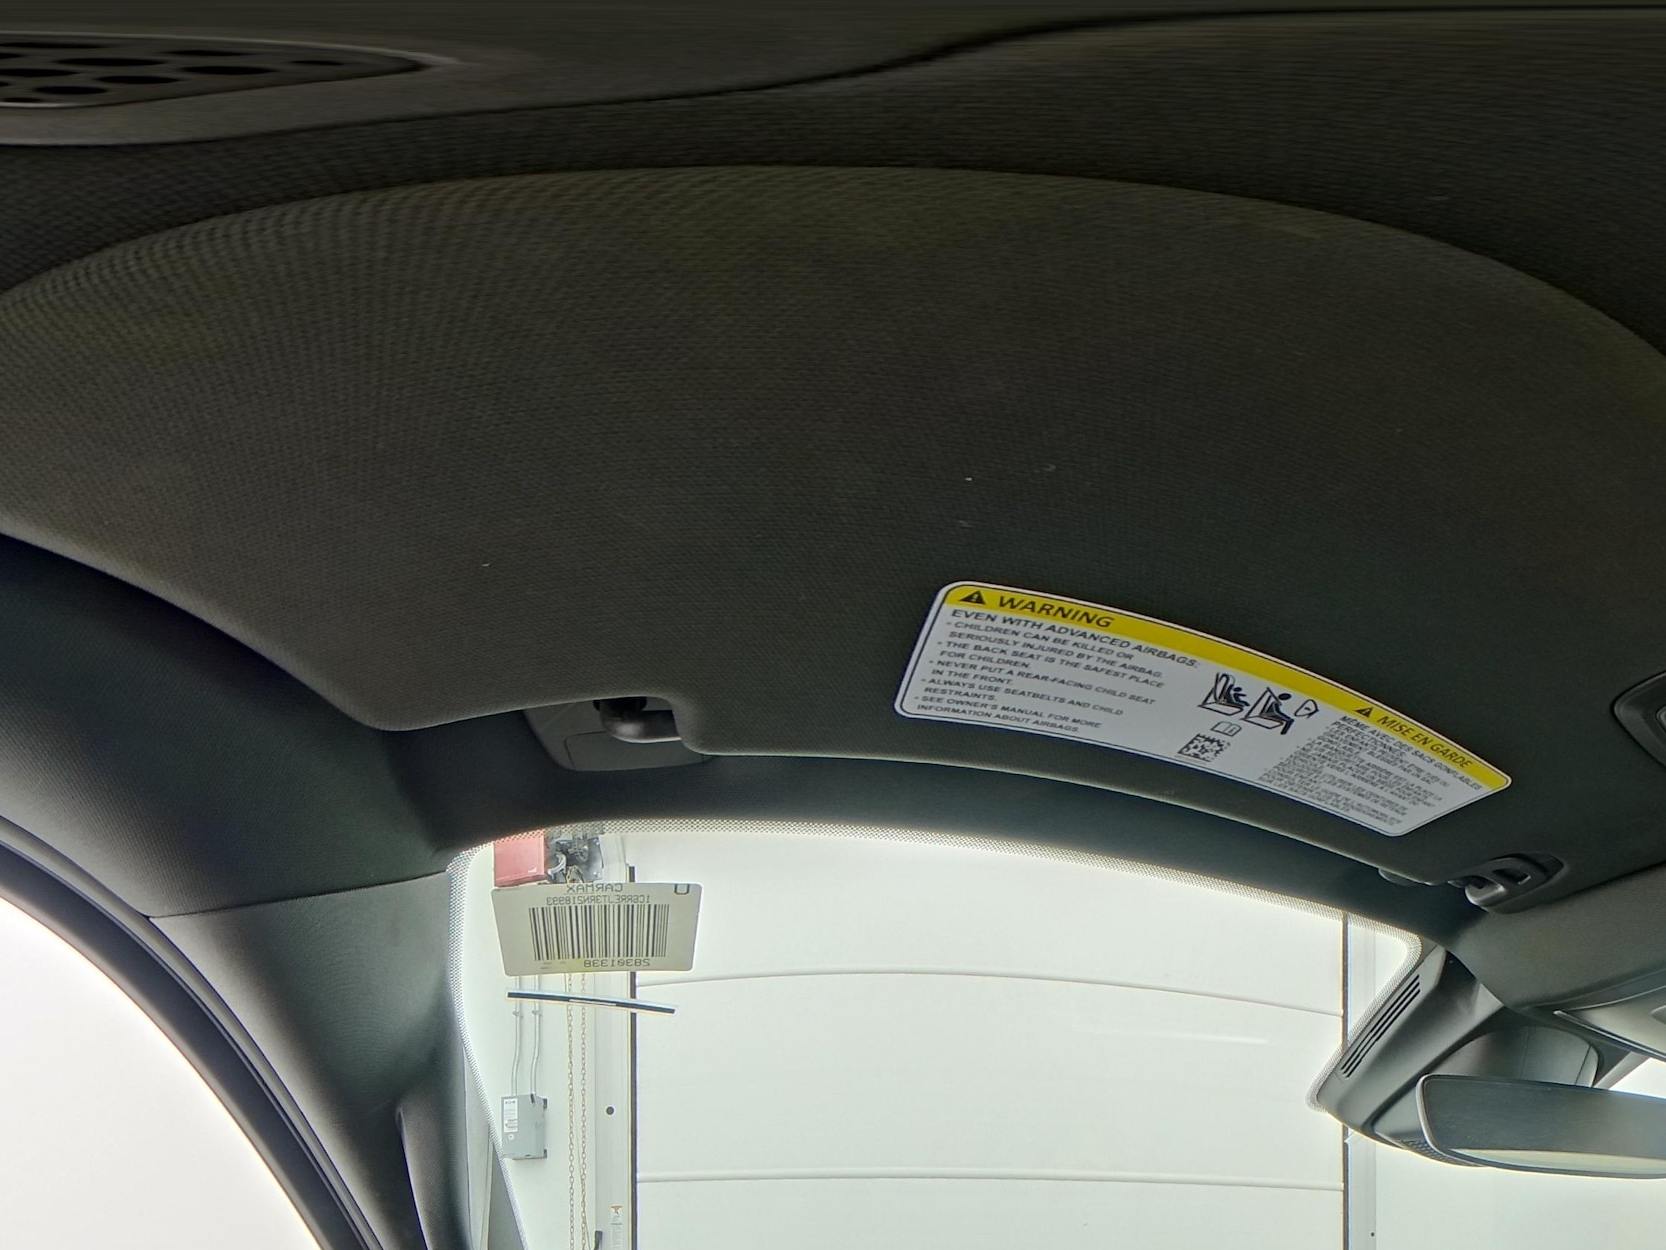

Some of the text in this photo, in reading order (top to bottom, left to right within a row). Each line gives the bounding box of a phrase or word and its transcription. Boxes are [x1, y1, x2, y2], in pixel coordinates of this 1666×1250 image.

[951, 608, 996, 622] EVEN
[1001, 615, 1043, 629] WITH
[1045, 623, 1130, 649] ADVANCED
[997, 595, 1114, 629] WARNING
[939, 649, 966, 659] FOR
[948, 630, 1019, 647] SERIOUSLY
[1021, 641, 1073, 657] INJURED
[1075, 652, 1093, 661] BY
[1095, 656, 1117, 667] THE
[953, 620, 1134, 660] CHILDREN CAN BE KILLED OR
[936, 658, 978, 670] NEVER
[979, 665, 1004, 674] PUT
[1016, 670, 1093, 691] REAR-FACING
[1094, 685, 1127, 699] CHILD
[1127, 693, 1156, 705] SEAT
[945, 640, 1164, 689] THE BACK SEAT IS THE SAFEST PLACE
[947, 670, 970, 680] THE
[921, 694, 944, 704] SEE
[999, 705, 1045, 719] MANUAL
[1047, 713, 1069, 723] FOR
[1070, 717, 1101, 729] MORE
[924, 685, 998, 702] RESTRAINTS.
[927, 677, 1123, 716] ALWAYS USE SEATBELTS AND CHILD
[916, 703, 992, 719] INFORMATION
[991, 712, 1031, 725] ABOUT
[1377, 716, 1473, 768] MISE EN GARDE
